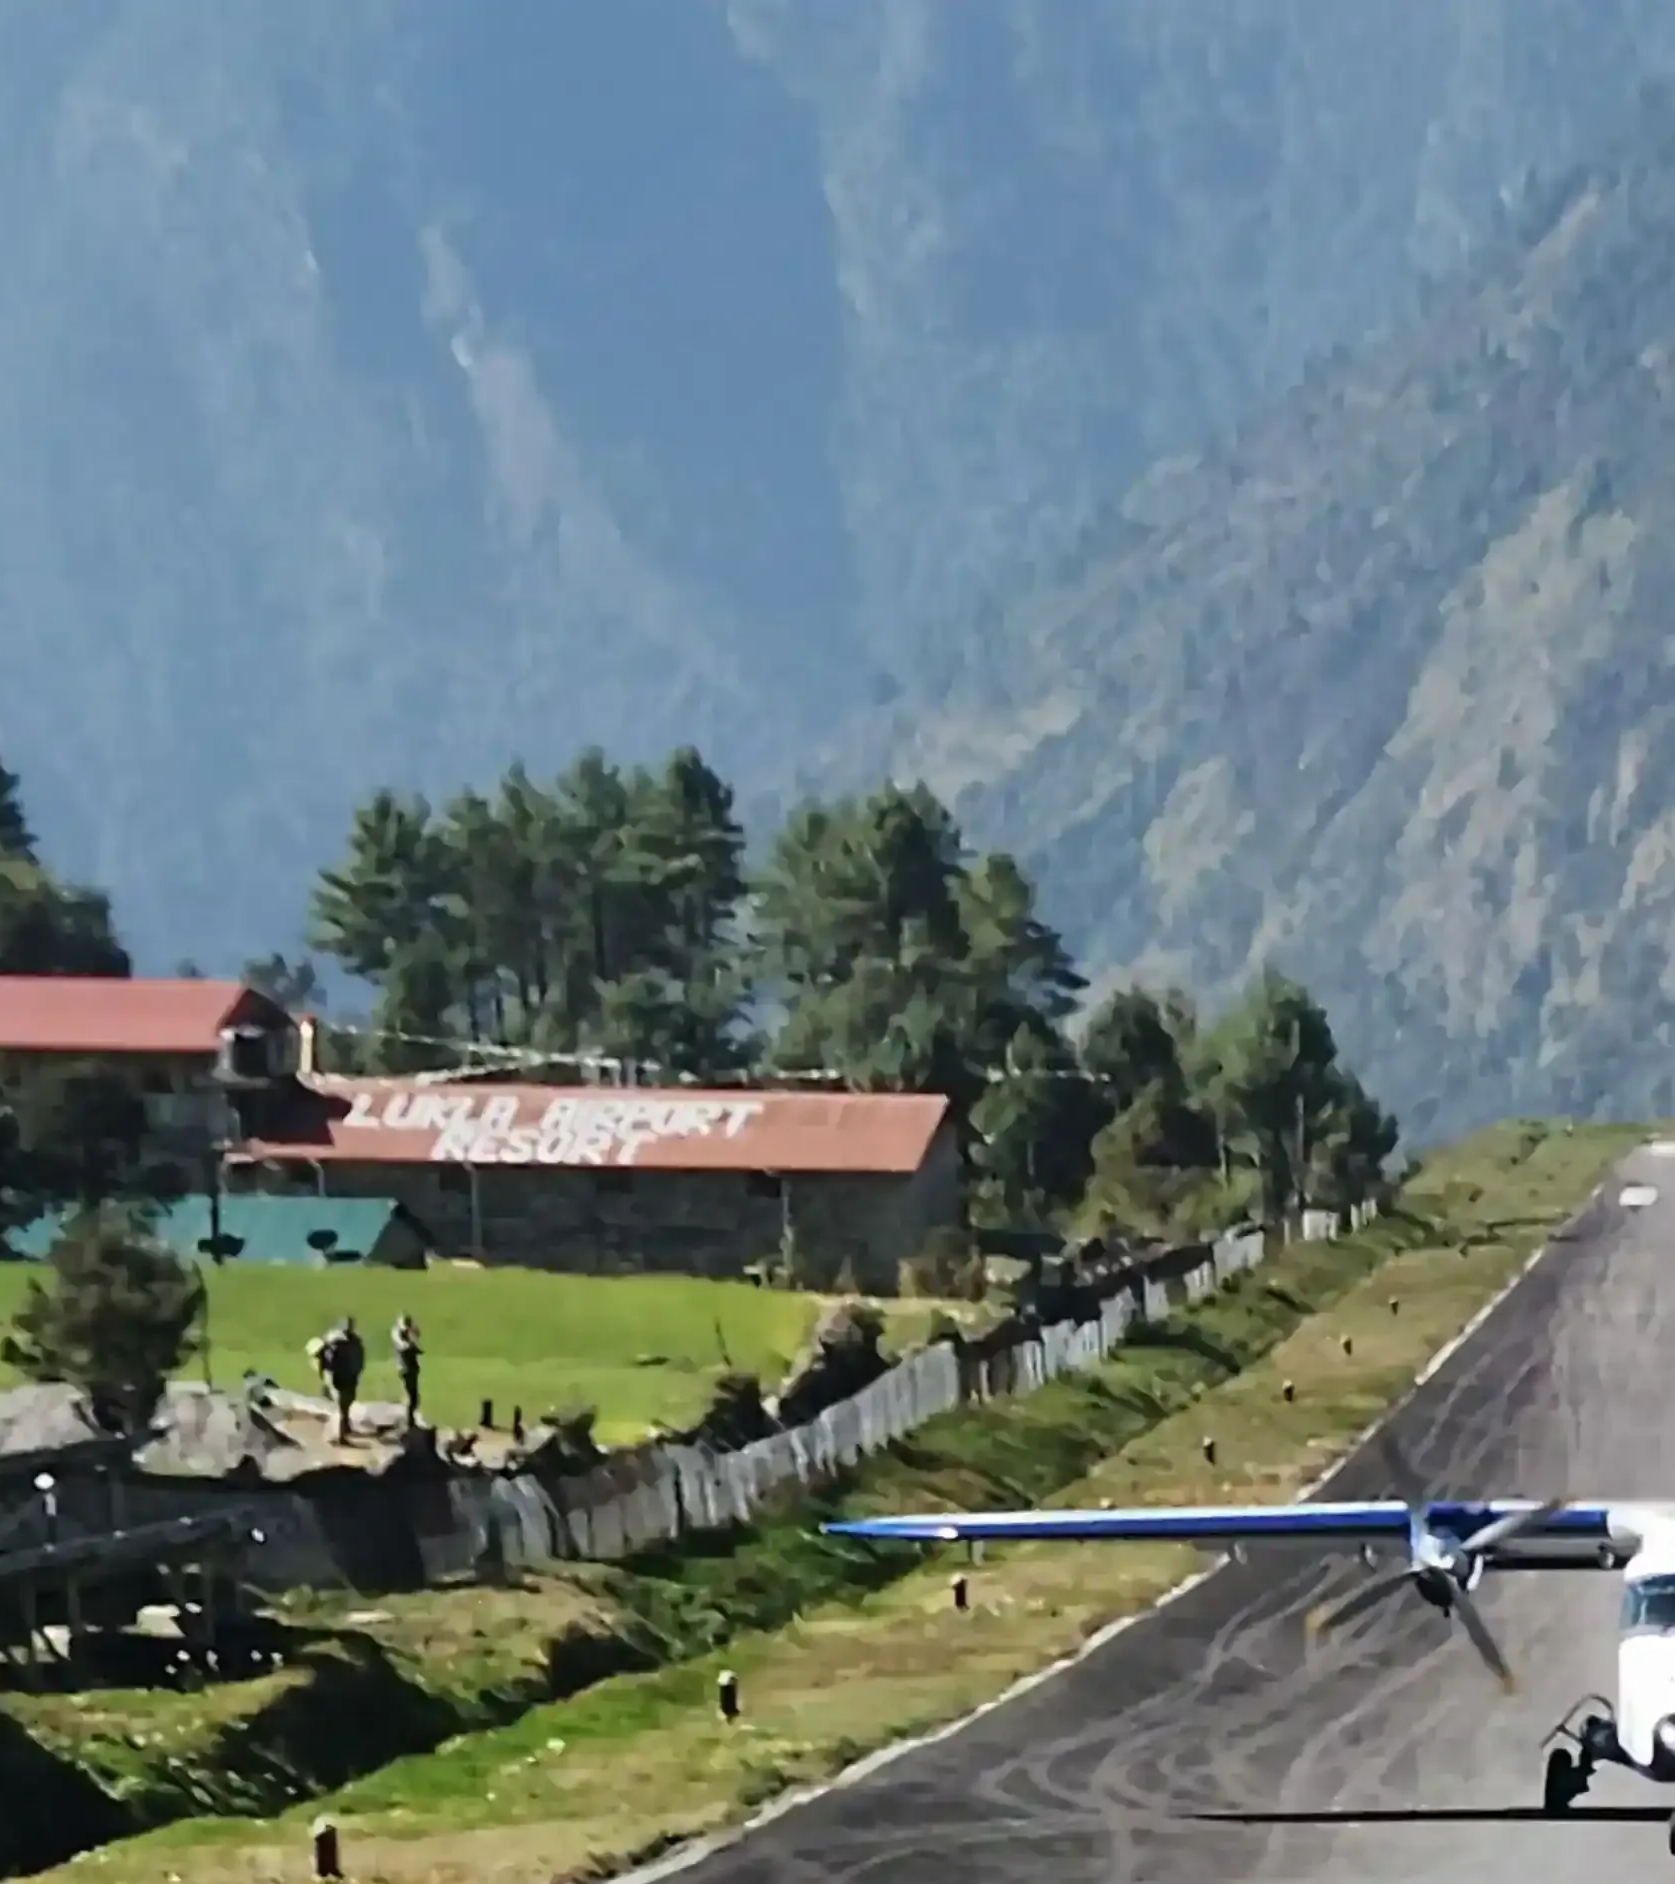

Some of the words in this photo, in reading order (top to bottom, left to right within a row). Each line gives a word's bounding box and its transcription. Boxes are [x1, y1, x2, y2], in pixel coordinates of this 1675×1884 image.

[343, 1093, 521, 1138] LUKLA
[539, 1096, 763, 1138] AIRPORT
[431, 1127, 657, 1165] RESORT
